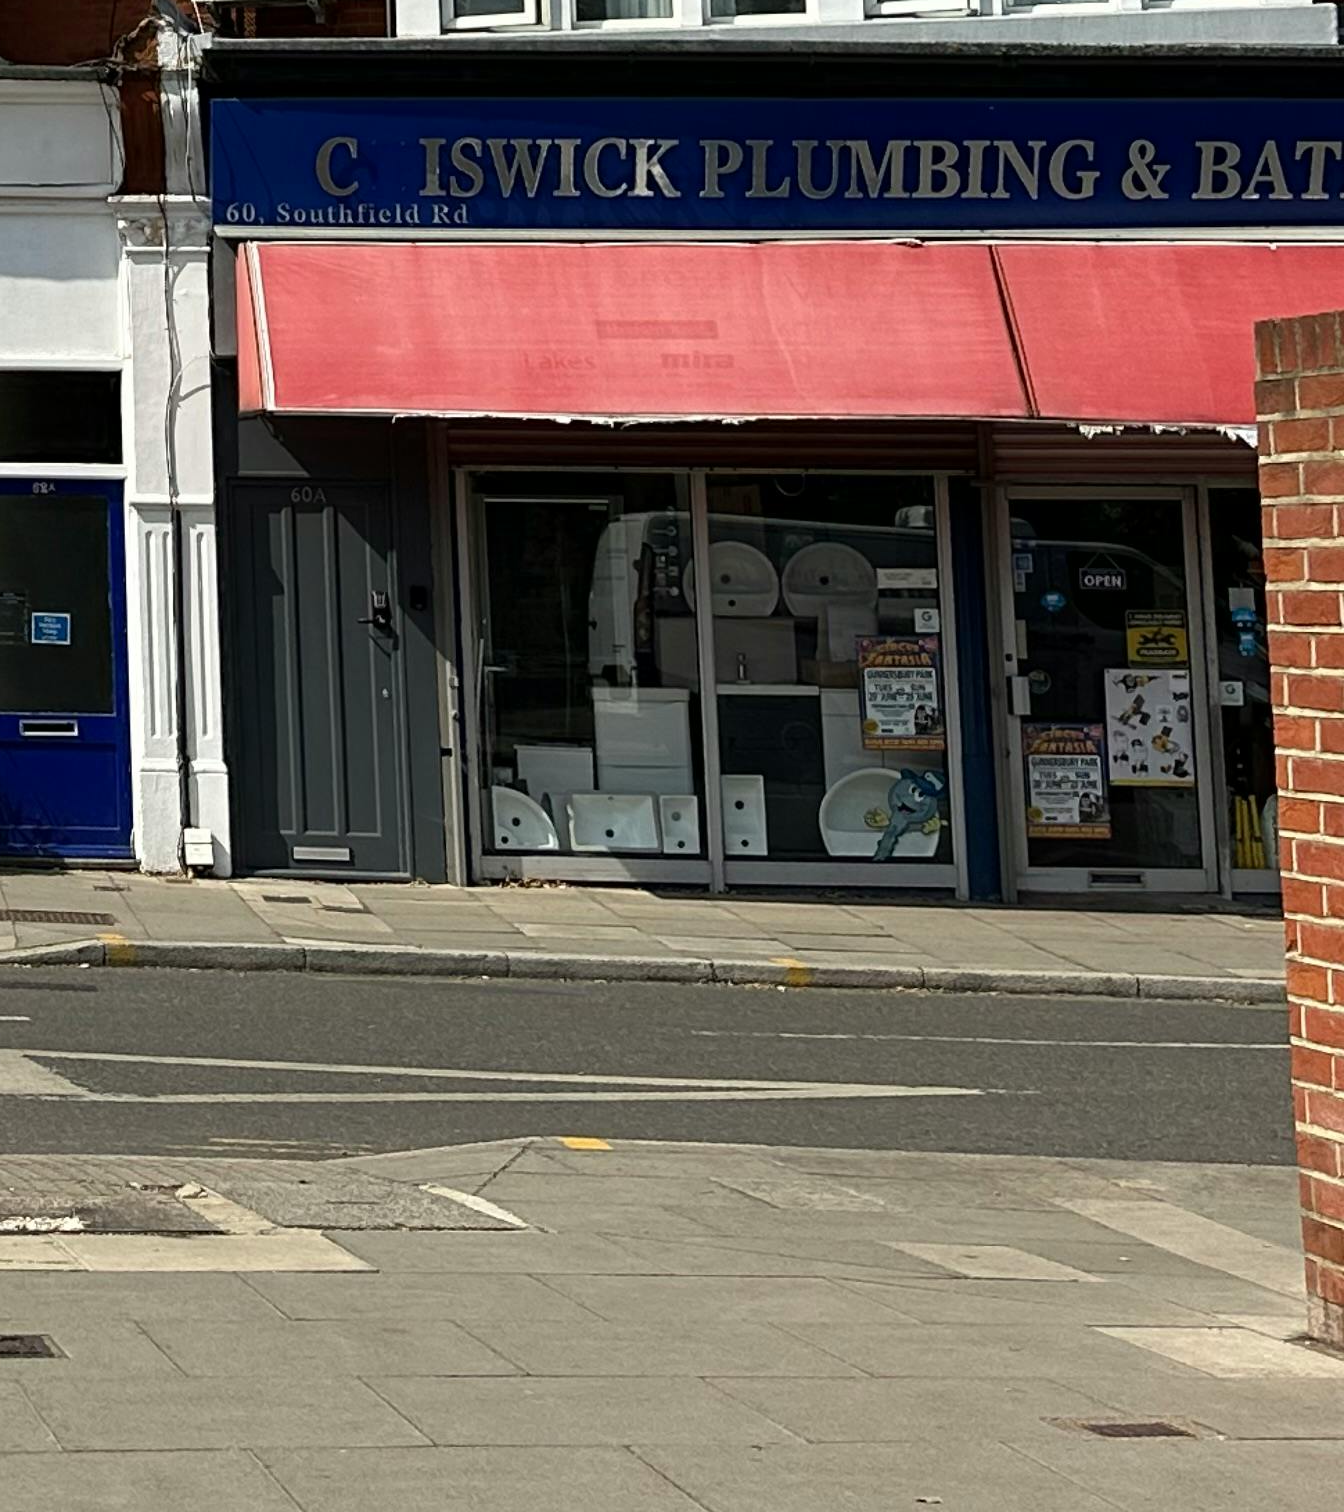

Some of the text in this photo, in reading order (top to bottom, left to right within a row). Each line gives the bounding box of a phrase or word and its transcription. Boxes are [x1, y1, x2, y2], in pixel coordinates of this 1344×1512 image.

[699, 138, 1101, 200] PLUMBING
[1120, 139, 1171, 200] &
[1191, 140, 1344, 200] BAT
[276, 202, 420, 224] Southfield
[431, 203, 469, 225] Rd
[290, 486, 327, 504] 60A
[1084, 574, 1122, 587] OPEN
